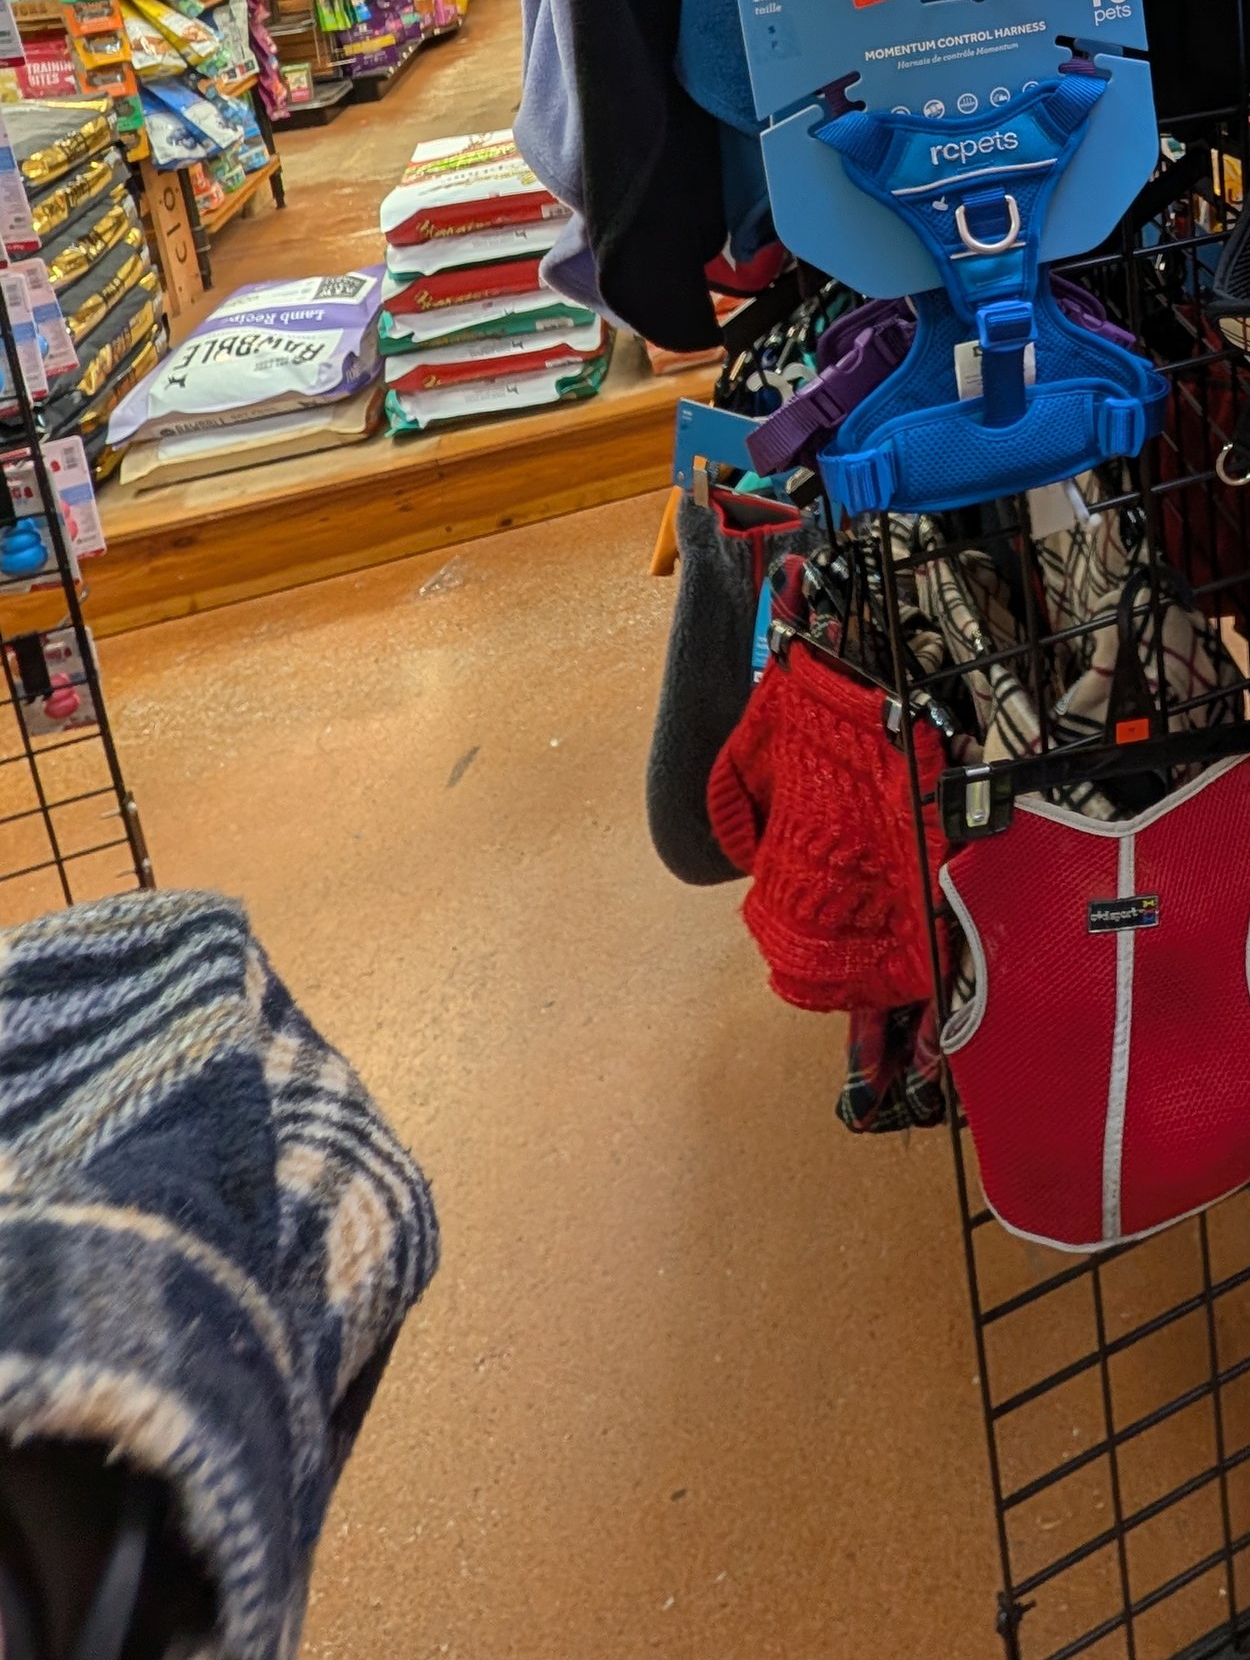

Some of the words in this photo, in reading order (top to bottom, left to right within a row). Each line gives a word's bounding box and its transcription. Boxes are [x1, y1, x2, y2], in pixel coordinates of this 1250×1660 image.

[755, 2, 782, 15] taille
[1094, 3, 1132, 26] pets
[865, 40, 936, 61] MOMENTUM
[937, 30, 993, 49] CONTROL
[994, 20, 1046, 39] HARNESS
[897, 58, 931, 70] Harnais
[932, 55, 942, 64] de
[975, 42, 1019, 56] Momentum
[929, 130, 1019, 166] rcpets
[280, 308, 326, 325] Lamb
